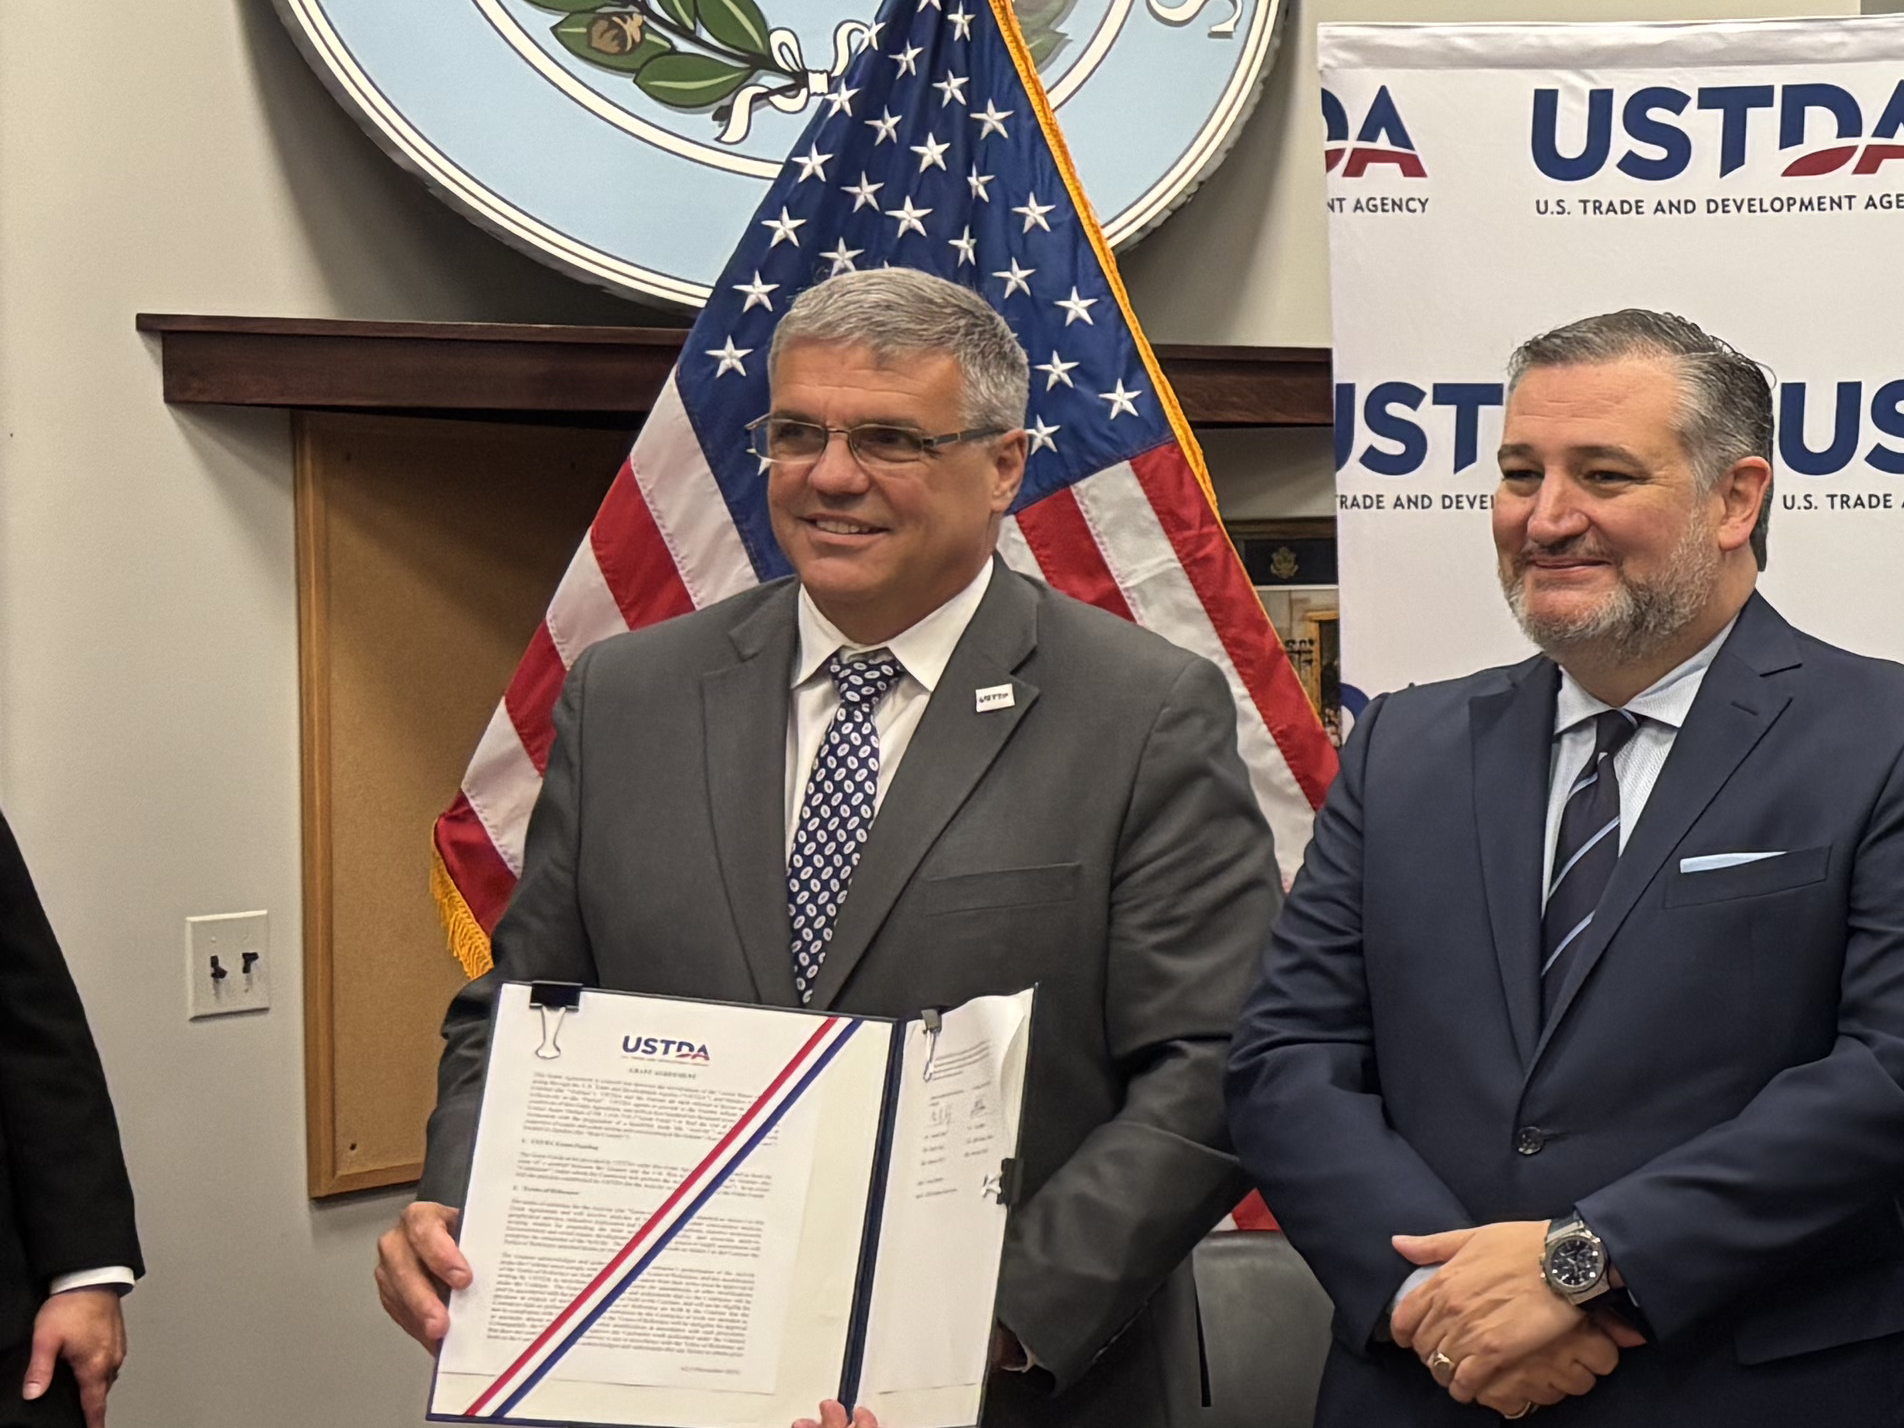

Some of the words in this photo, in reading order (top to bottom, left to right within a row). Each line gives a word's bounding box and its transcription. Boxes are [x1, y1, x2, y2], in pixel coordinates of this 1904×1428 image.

[1352, 196, 1429, 214] AGENCY
[1535, 199, 1571, 216] U.S.
[1578, 199, 1645, 216] TRADE
[1653, 198, 1697, 215] AND
[1706, 194, 1857, 215] DEVELOPMENT
[1338, 493, 1386, 510] RADE
[1392, 493, 1433, 510] AND
[1782, 493, 1818, 511] U.S.
[1825, 493, 1893, 510] TRADE
[622, 1035, 711, 1061] USTDA
